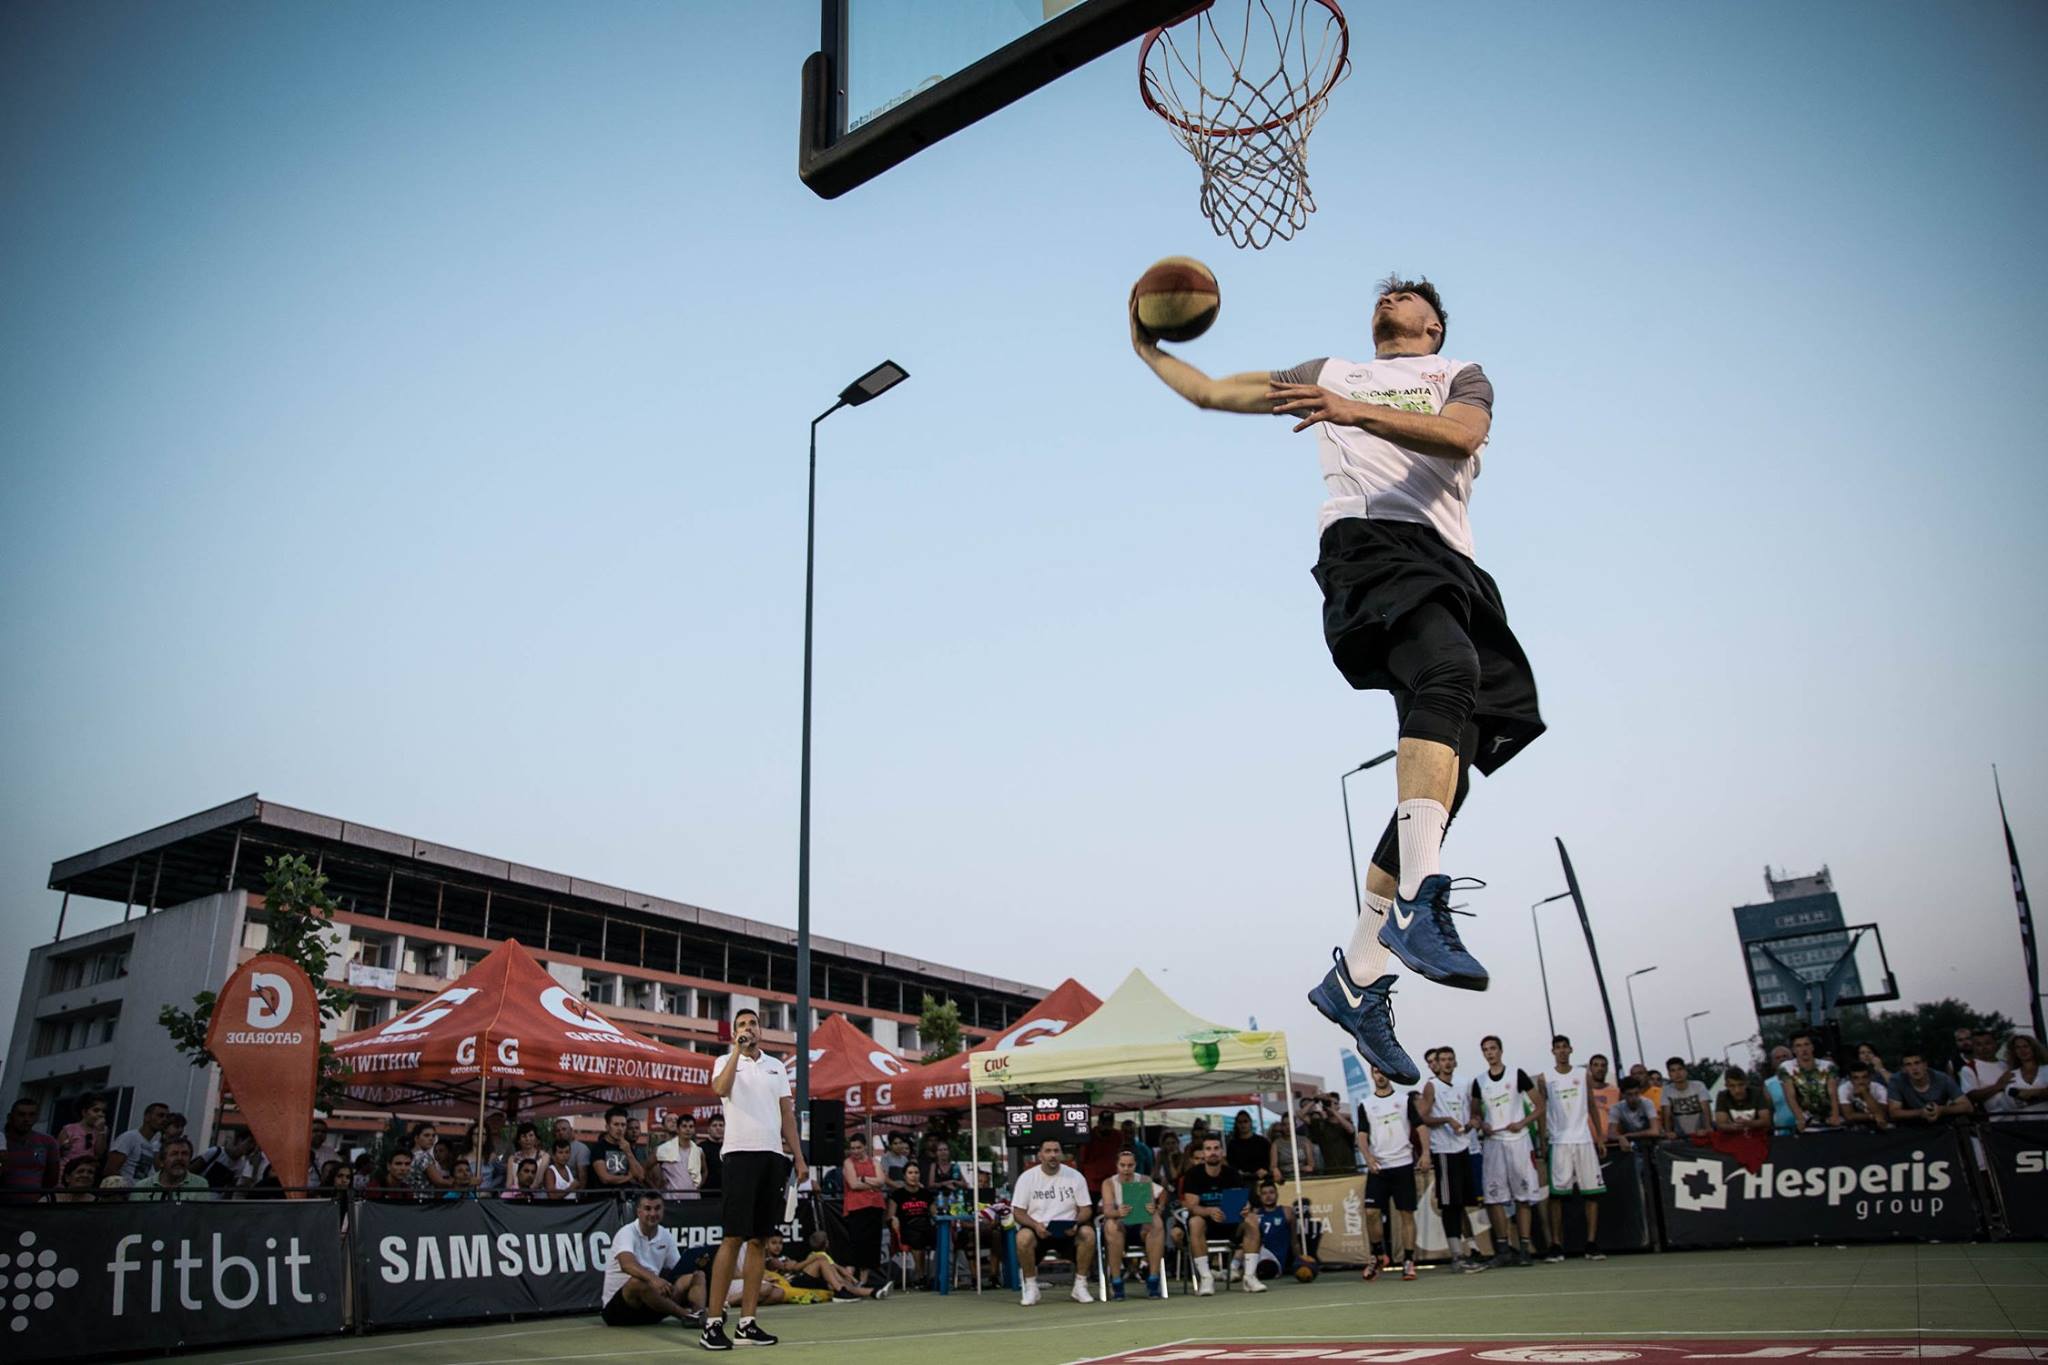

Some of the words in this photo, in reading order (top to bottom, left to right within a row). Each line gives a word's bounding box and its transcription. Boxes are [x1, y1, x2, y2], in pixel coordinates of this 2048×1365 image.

[559, 1053, 710, 1085] #WINFROMWITHIN
[984, 1055, 1010, 1073] CIUC
[1012, 1112, 1028, 1123] 22
[1035, 1112, 1061, 1122] 01:07
[1738, 1150, 1951, 1206] Hesperis
[1856, 1197, 1944, 1220] group
[1263, 1222, 1272, 1234] 7
[379, 1230, 611, 1283] SAMSUNG
[106, 1232, 313, 1316] fitbit
